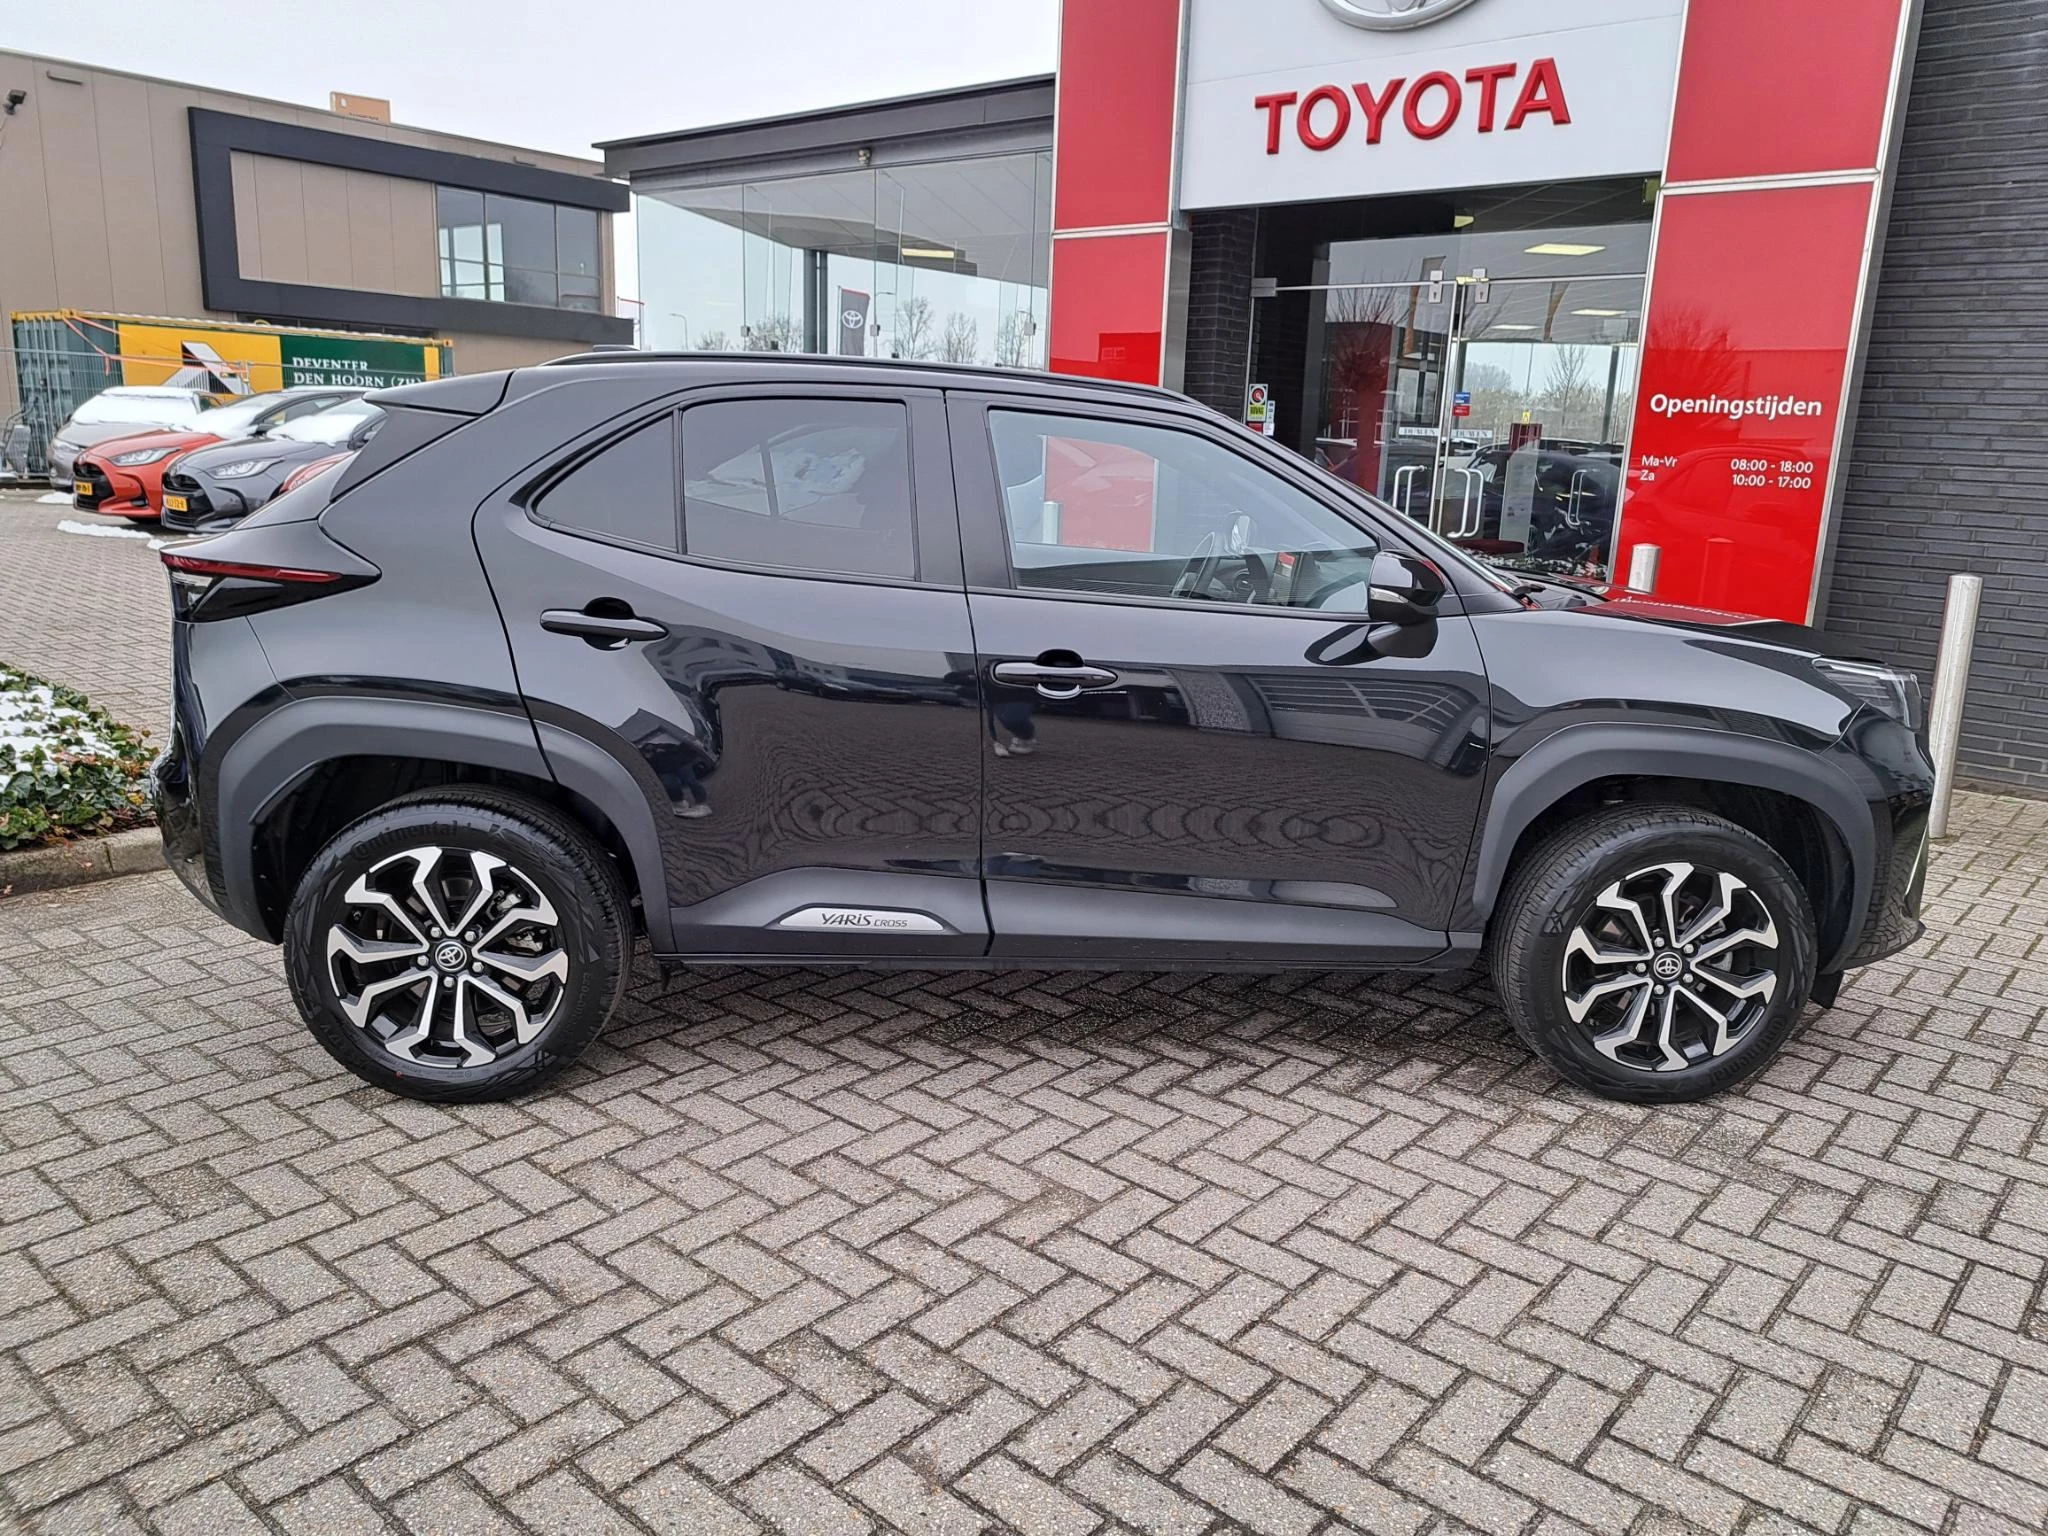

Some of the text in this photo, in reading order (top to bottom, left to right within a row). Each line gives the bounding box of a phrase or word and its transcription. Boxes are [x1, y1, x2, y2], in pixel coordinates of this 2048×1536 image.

[1254, 57, 1572, 155] TOYOTA
[292, 356, 369, 371] DEVENTER
[293, 372, 325, 385] DEN
[331, 373, 385, 387] HOORN
[1650, 393, 1823, 421] Openingstijden
[1641, 454, 1678, 468] Ma-Vr
[1730, 458, 1768, 472] 08:00
[1779, 460, 1814, 474] 18:00
[1639, 469, 1655, 481] Za
[1732, 474, 1766, 487] 10:00
[1777, 476, 1812, 489] 17:00
[873, 919, 909, 928] CROSS
